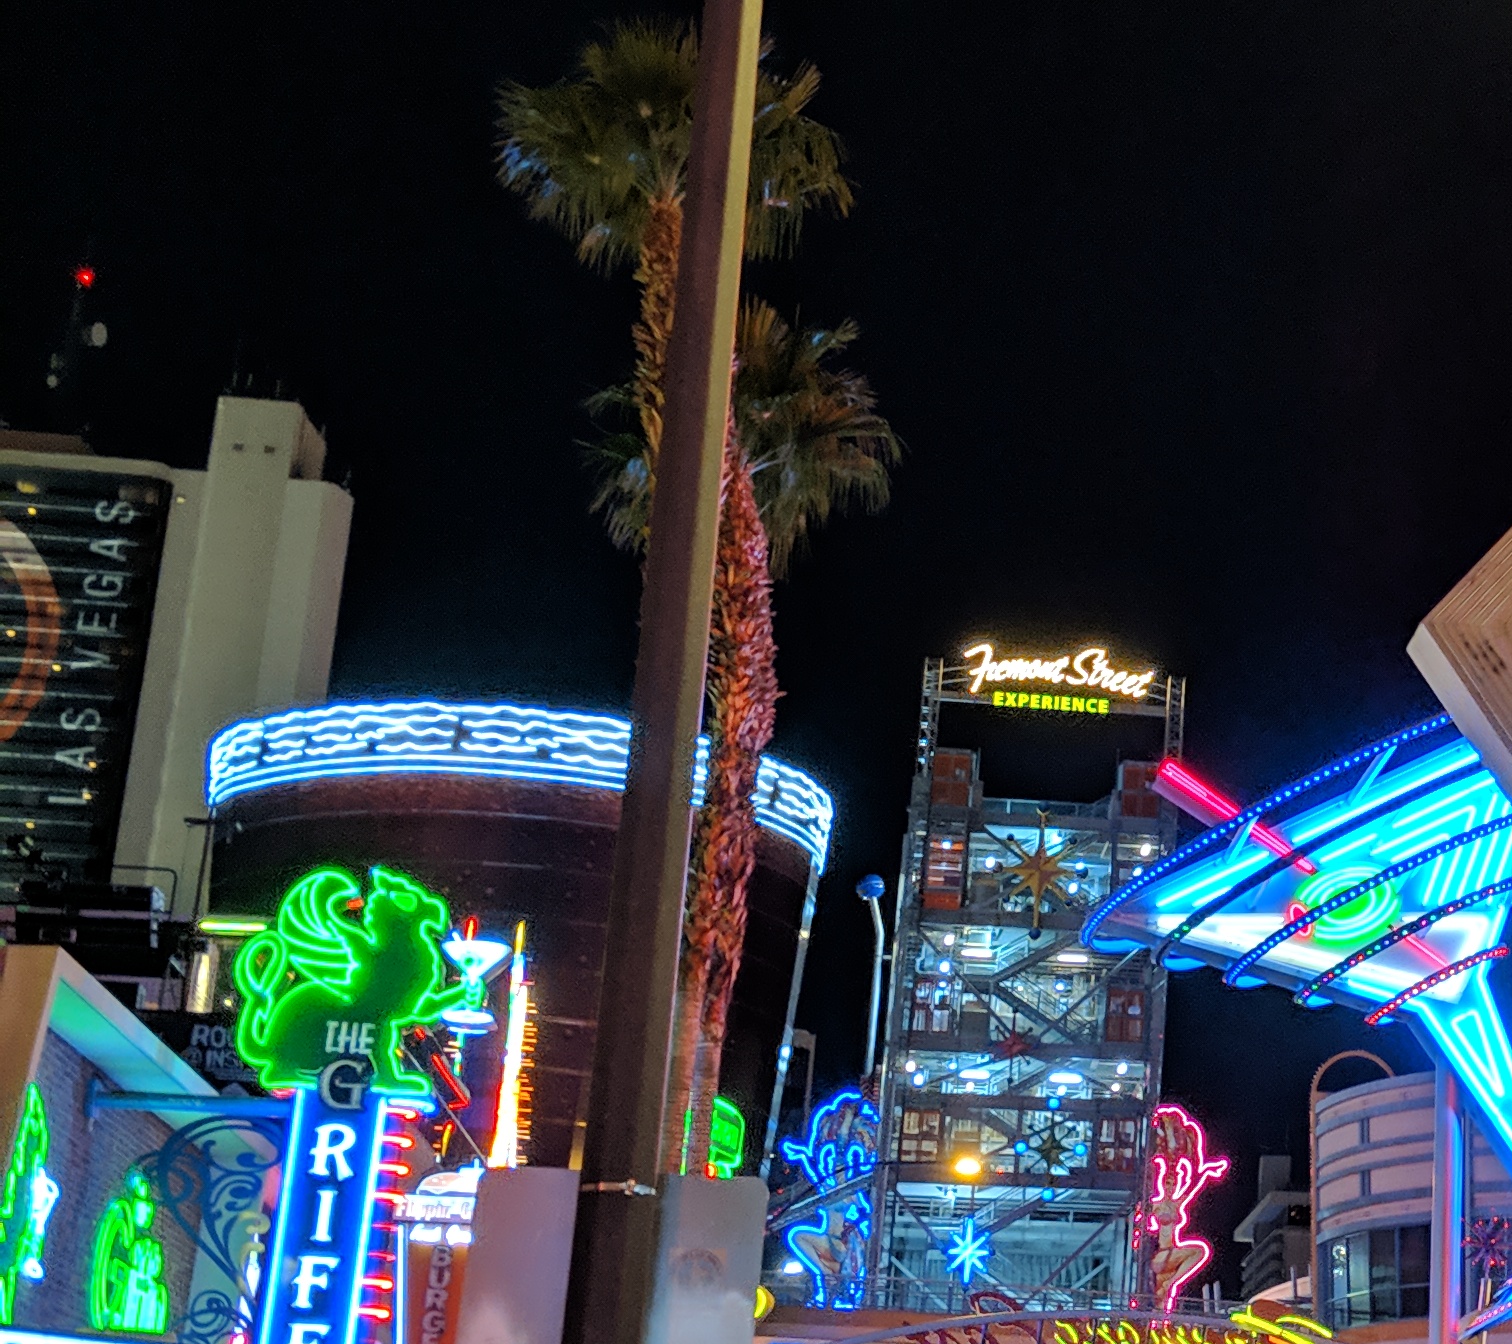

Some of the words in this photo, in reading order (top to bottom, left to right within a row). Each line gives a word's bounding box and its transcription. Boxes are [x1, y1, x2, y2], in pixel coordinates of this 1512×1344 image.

[70, 498, 137, 671] VEGAS
[964, 643, 1069, 694] Fremont
[1066, 647, 1155, 698] Street
[993, 691, 1110, 714] EXPERIENCE
[47, 704, 101, 806] LAS
[325, 1020, 376, 1054] THE
